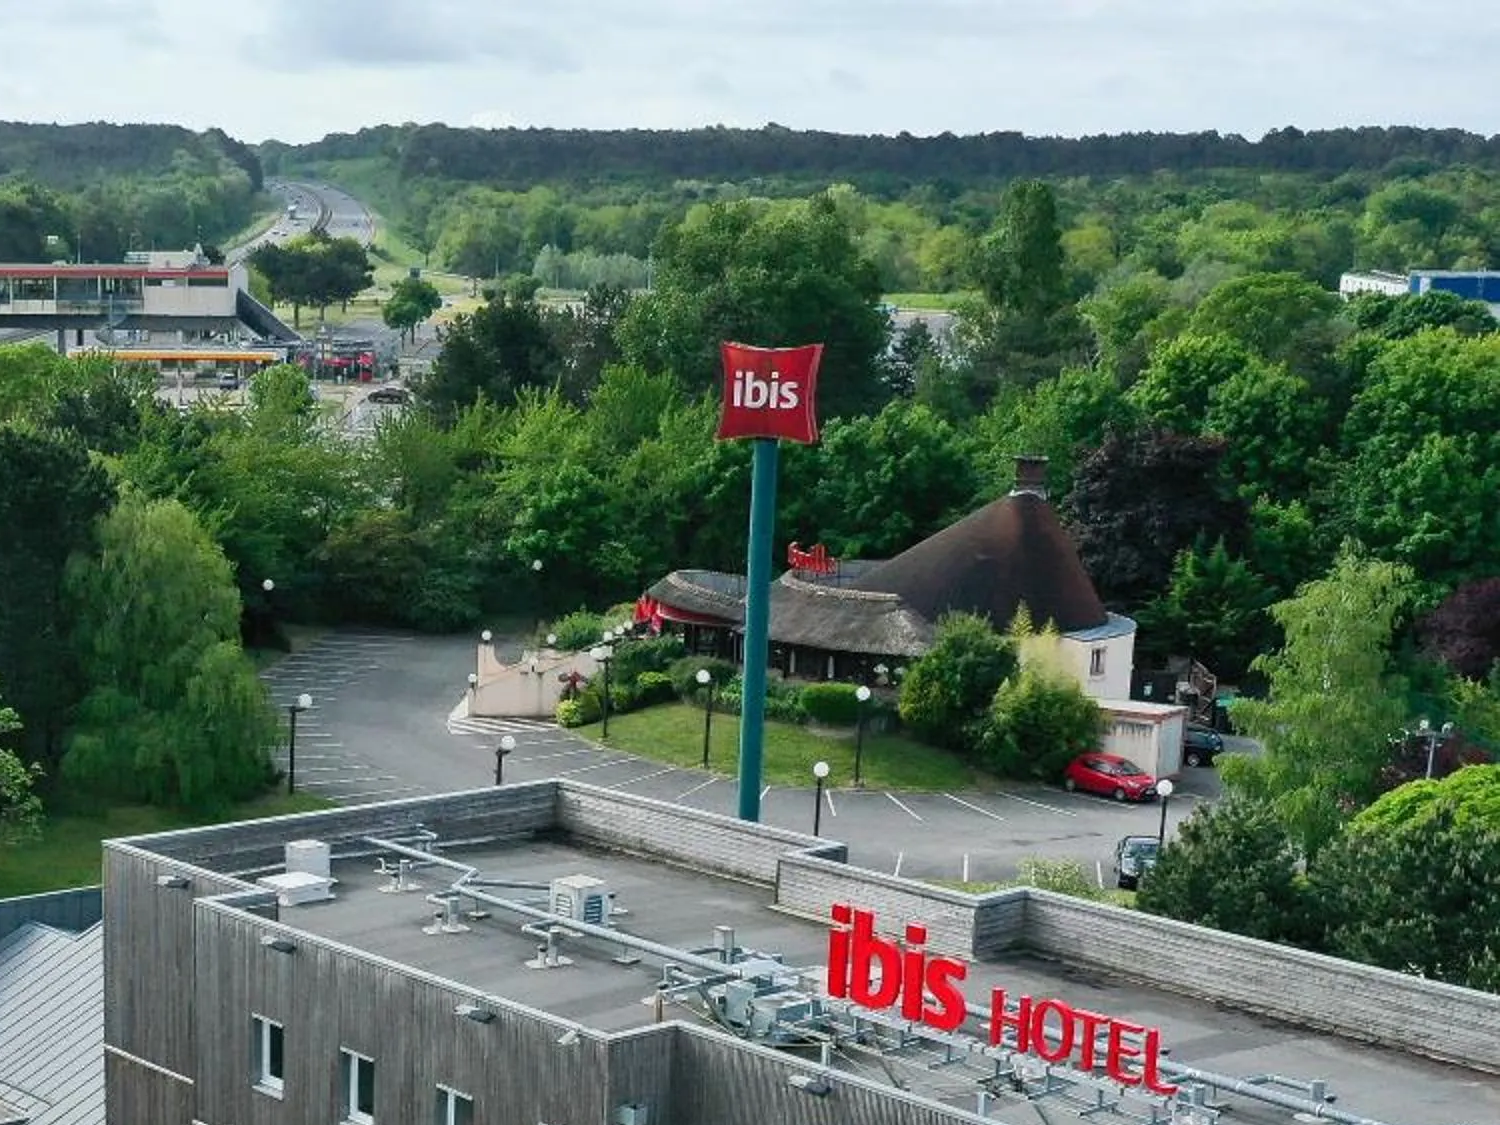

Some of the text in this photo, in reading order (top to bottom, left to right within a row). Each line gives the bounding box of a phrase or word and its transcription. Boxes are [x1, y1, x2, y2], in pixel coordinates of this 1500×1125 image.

[733, 371, 799, 409] ibis
[827, 902, 1180, 1097] ibis HOTEL
